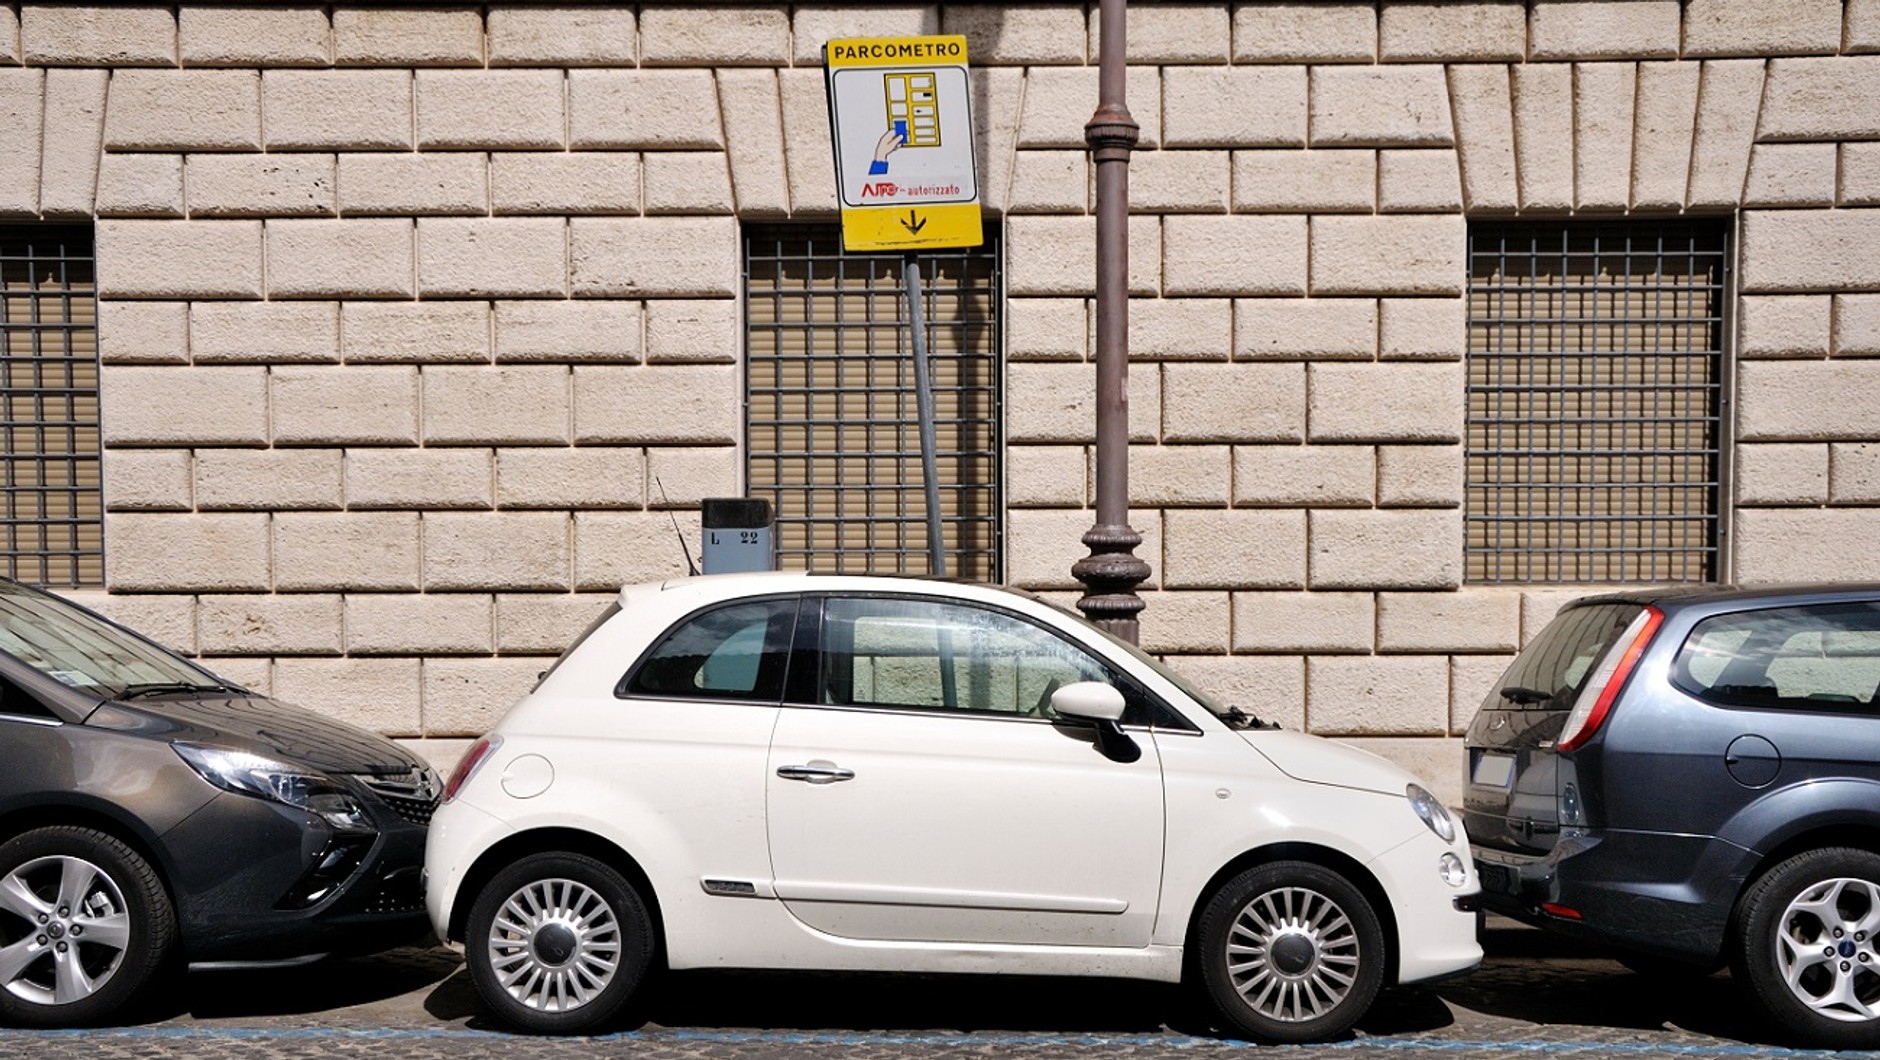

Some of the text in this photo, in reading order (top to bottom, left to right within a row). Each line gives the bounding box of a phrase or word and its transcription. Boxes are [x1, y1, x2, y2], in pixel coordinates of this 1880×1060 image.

[834, 42, 960, 59] PARCOMETRO
[907, 184, 960, 196] autorizzato
[711, 531, 758, 545] L 22
